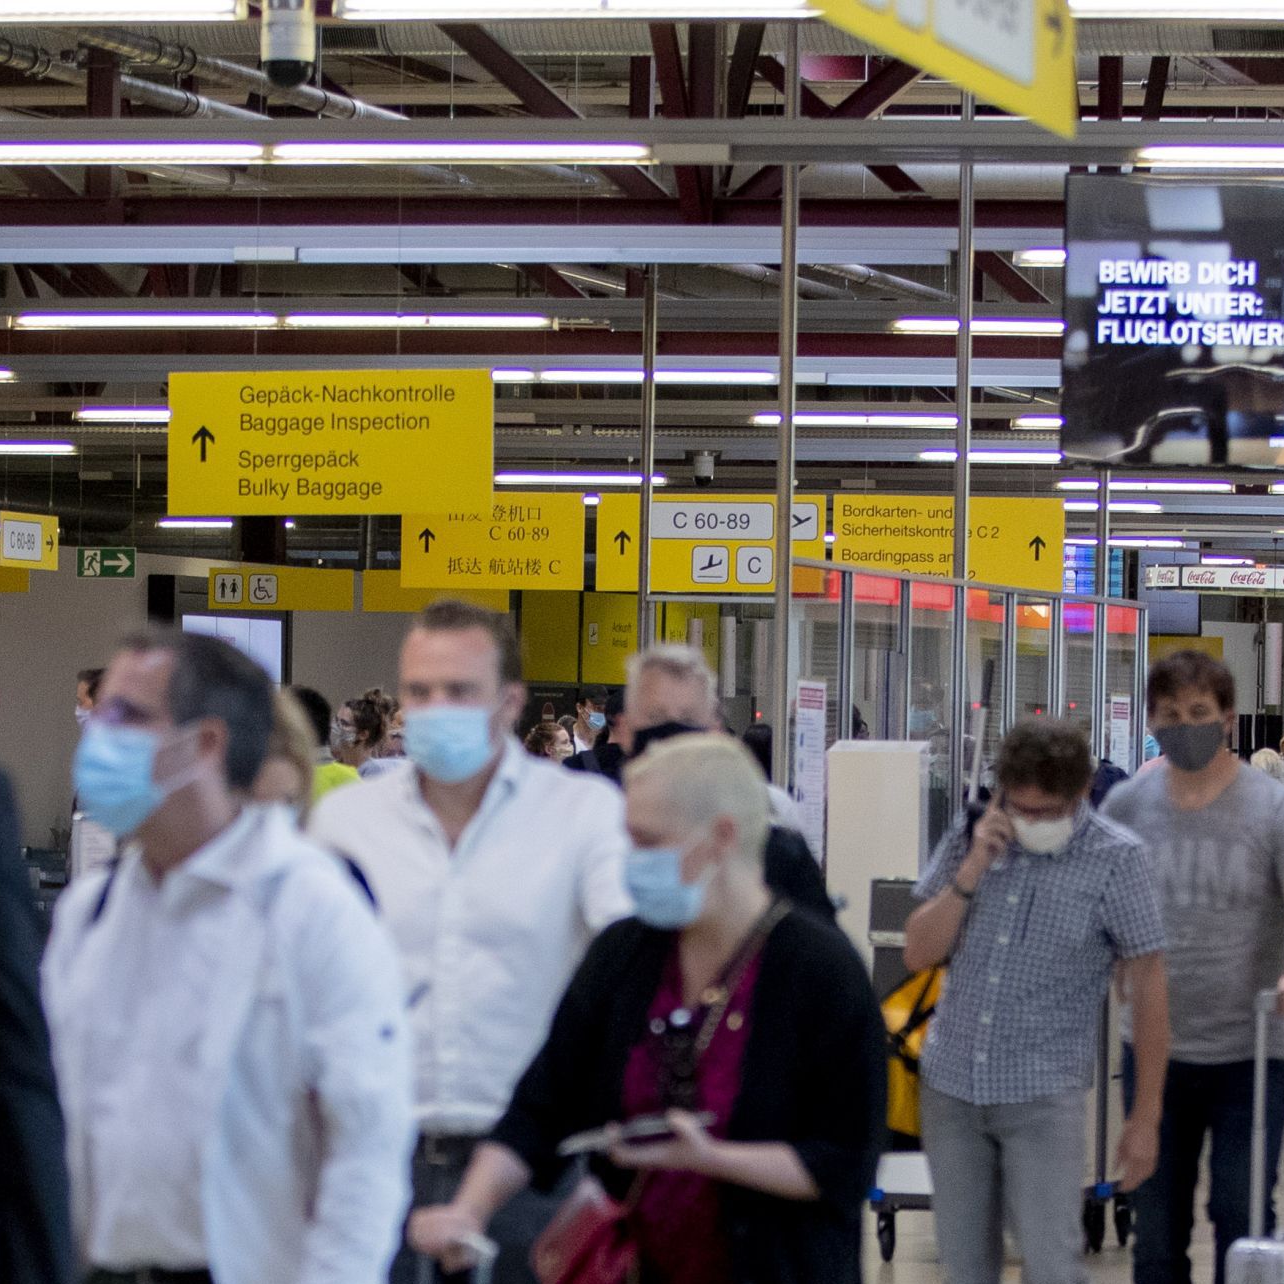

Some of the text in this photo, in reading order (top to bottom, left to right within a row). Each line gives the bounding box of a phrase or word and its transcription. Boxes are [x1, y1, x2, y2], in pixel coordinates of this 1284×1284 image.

[1099, 260, 1190, 284] BEWIRB
[1198, 261, 1256, 285] DICH
[1098, 290, 1263, 316] JETZT UNTER:
[239, 385, 455, 407] Gepäck-Nachkontrolle
[239, 413, 430, 435] Baggage Inspection
[238, 449, 359, 472] Sperrgepäck
[238, 478, 382, 500] Bulky Baggage
[491, 504, 541, 523] 登机口
[673, 512, 750, 530] C 60-89
[843, 504, 953, 519] Bordkarten- und
[489, 526, 549, 541] C 60-89
[842, 523, 999, 539] Sicherheitskontroe C 2
[10, 531, 35, 551] C 60-89
[448, 557, 482, 575] 抵达
[549, 560, 561, 575] C
[748, 557, 762, 574] C
[842, 549, 954, 565] Boardingpass an
